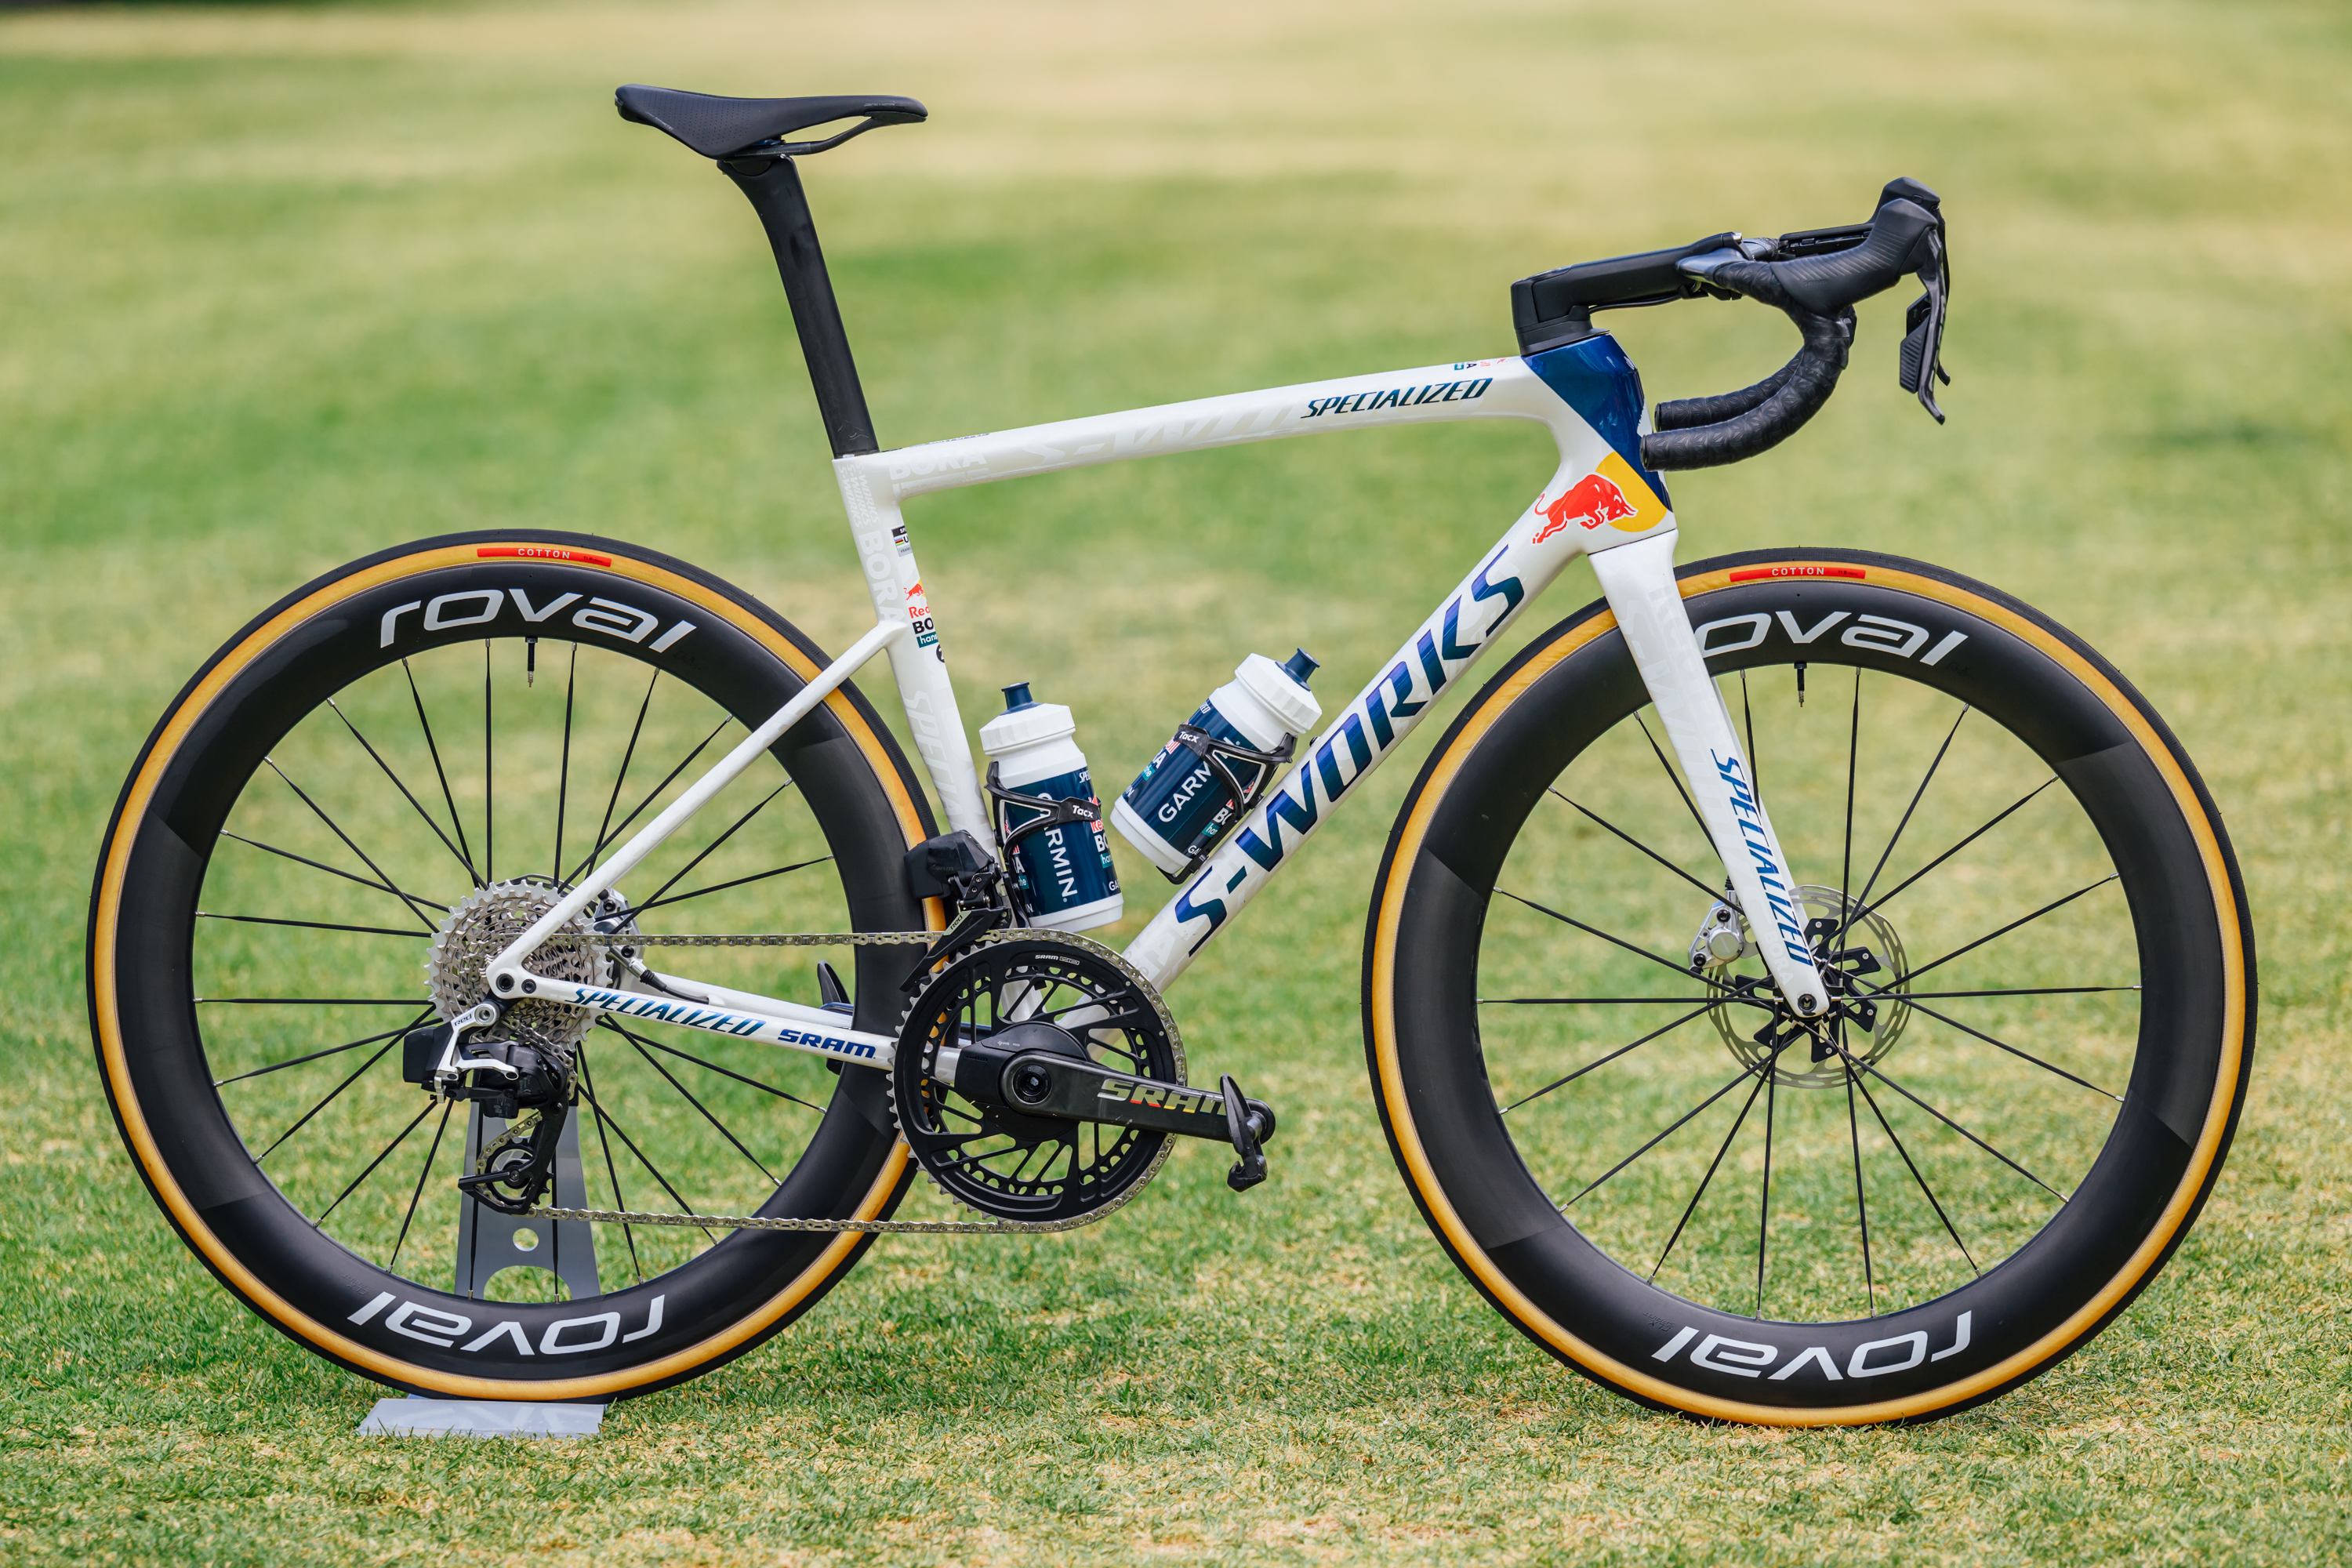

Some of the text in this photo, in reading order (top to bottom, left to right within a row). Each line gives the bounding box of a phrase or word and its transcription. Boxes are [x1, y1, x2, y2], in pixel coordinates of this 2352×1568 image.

[1301, 377, 1493, 419] SPECIALIZED
[518, 549, 570, 559] COTTON
[1772, 567, 1824, 576] COTTON
[380, 589, 697, 653] roval
[1693, 611, 1969, 666] oval
[1175, 543, 1525, 959] S-WORKS
[1179, 731, 1200, 743] Tacx
[1158, 737, 1234, 822] GARM
[1073, 805, 1094, 818] Tacx
[1038, 793, 1078, 898] RMIN
[1711, 747, 1813, 967] SPECIALIZED
[1762, 931, 1795, 985] BORA
[564, 988, 766, 1036] SPECIALIZED
[778, 1029, 876, 1059] SRAM
[1098, 1078, 1226, 1117] SRAM
[347, 1290, 665, 1356] roval
[1651, 1310, 1972, 1381] roval
